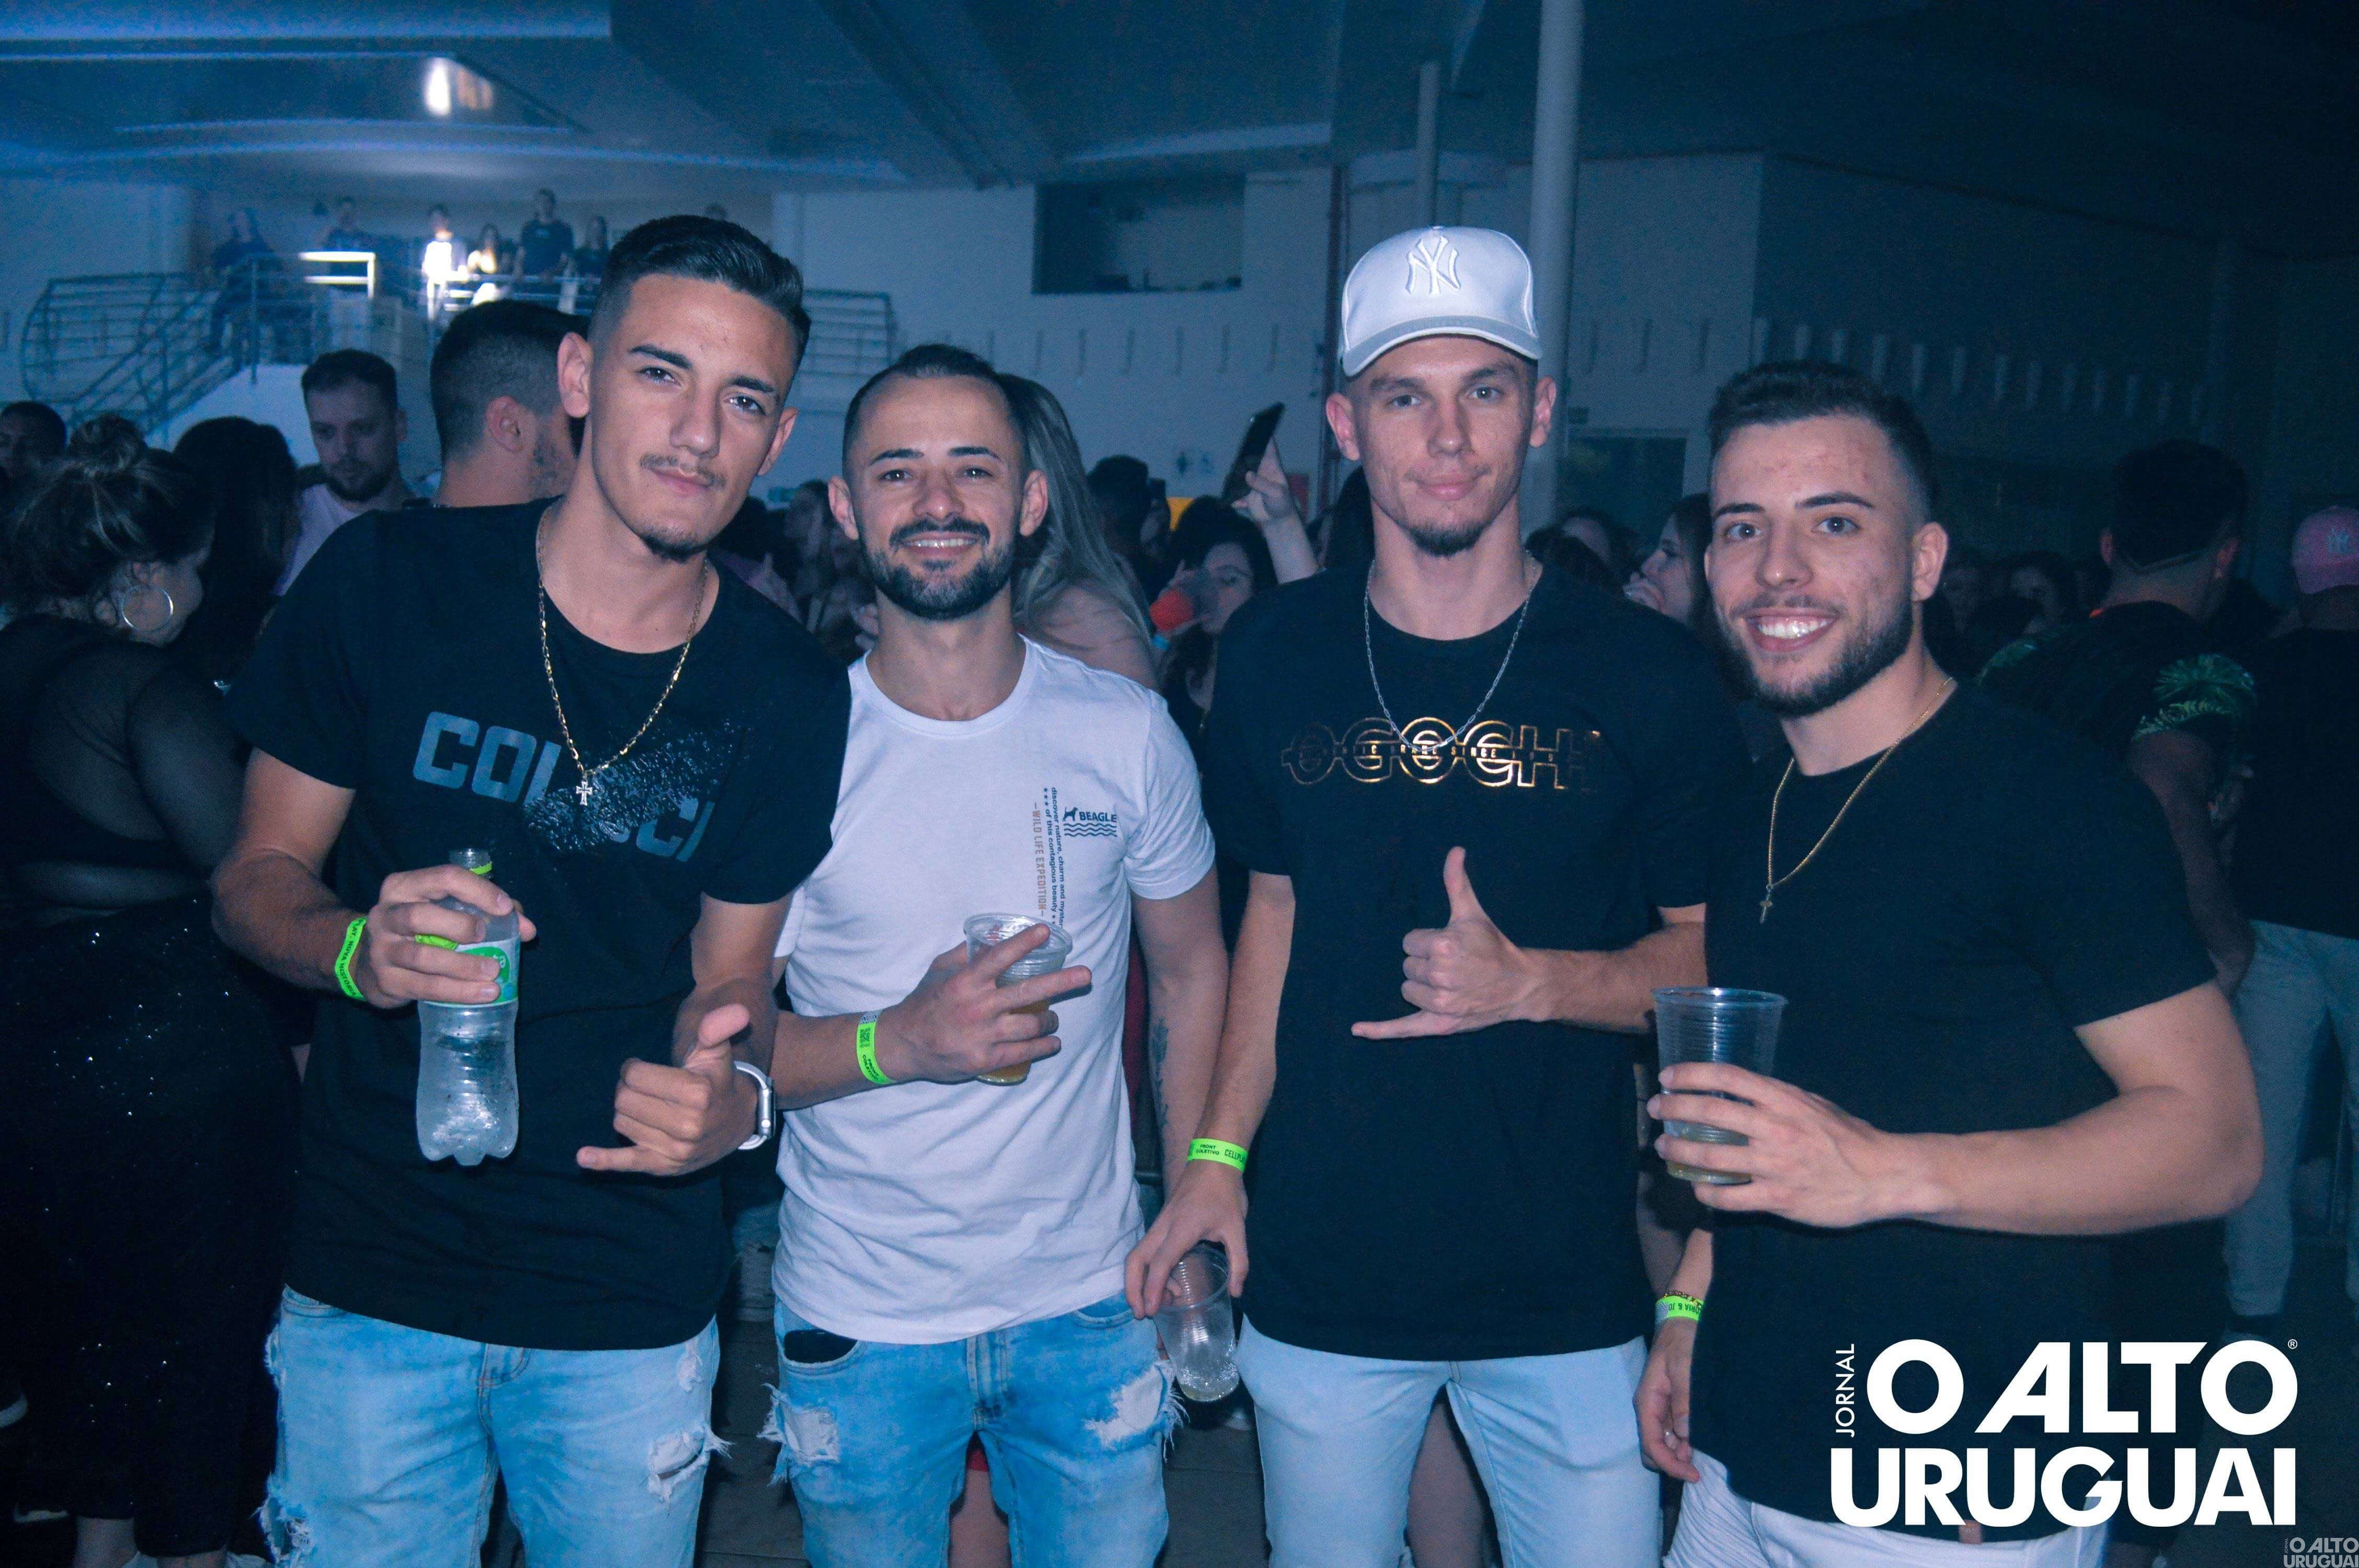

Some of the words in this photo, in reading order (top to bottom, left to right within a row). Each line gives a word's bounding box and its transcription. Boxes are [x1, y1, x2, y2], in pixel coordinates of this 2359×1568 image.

[1405, 235, 1461, 294] NY
[1051, 787, 1059, 824] discover
[1079, 811, 1117, 823] BEAGLE
[1034, 836, 1045, 855] LIFE
[1045, 809, 1051, 819] of
[1048, 837, 1057, 884] contagious
